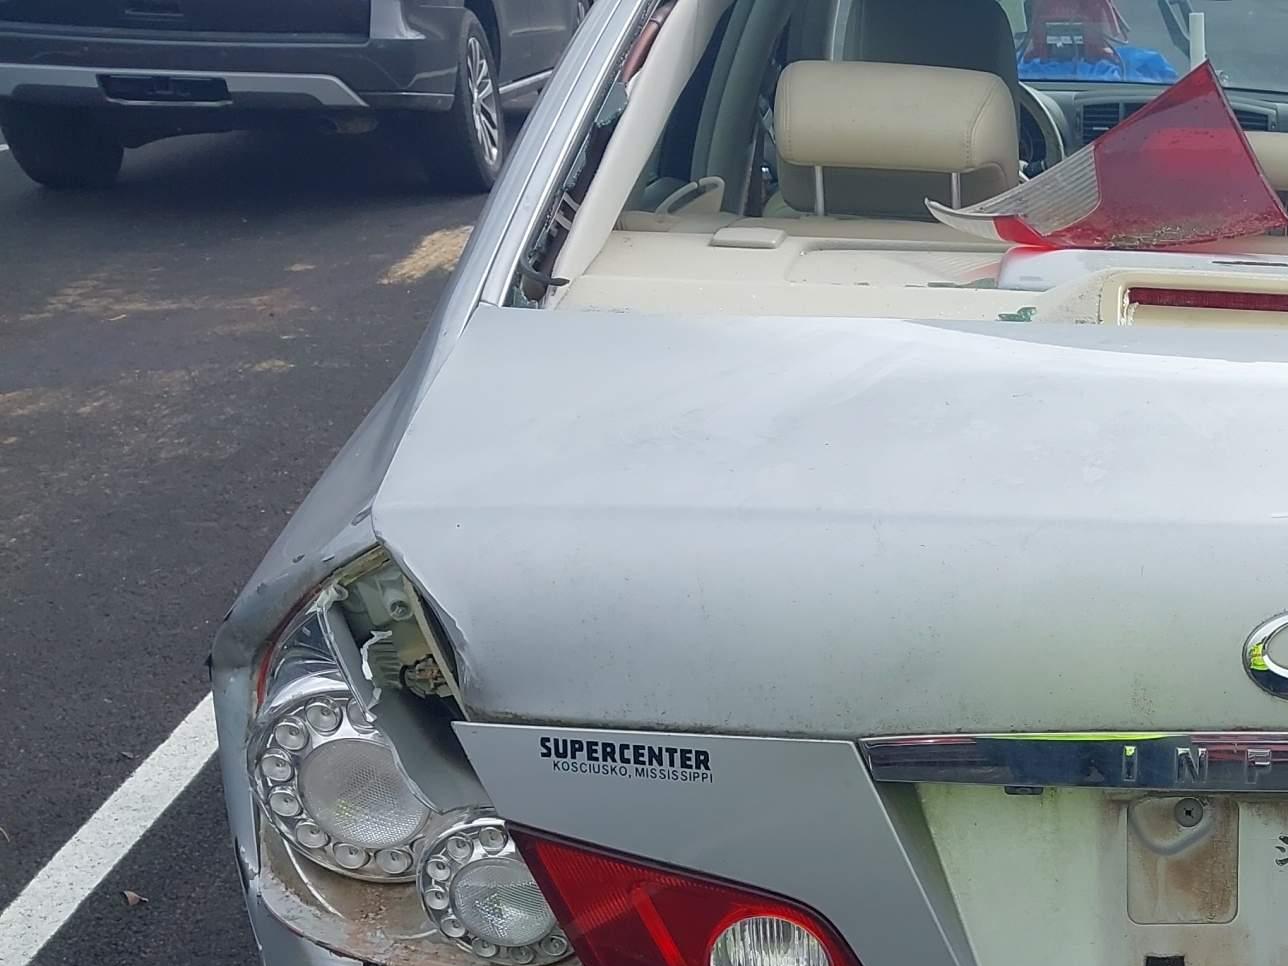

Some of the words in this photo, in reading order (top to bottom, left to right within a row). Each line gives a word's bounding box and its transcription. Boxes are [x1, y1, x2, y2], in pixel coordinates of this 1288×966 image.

[540, 737, 711, 771] SUPERCENTER
[553, 760, 632, 778] KOSCIUSKO,
[635, 767, 713, 783] MISSISSIPPI
